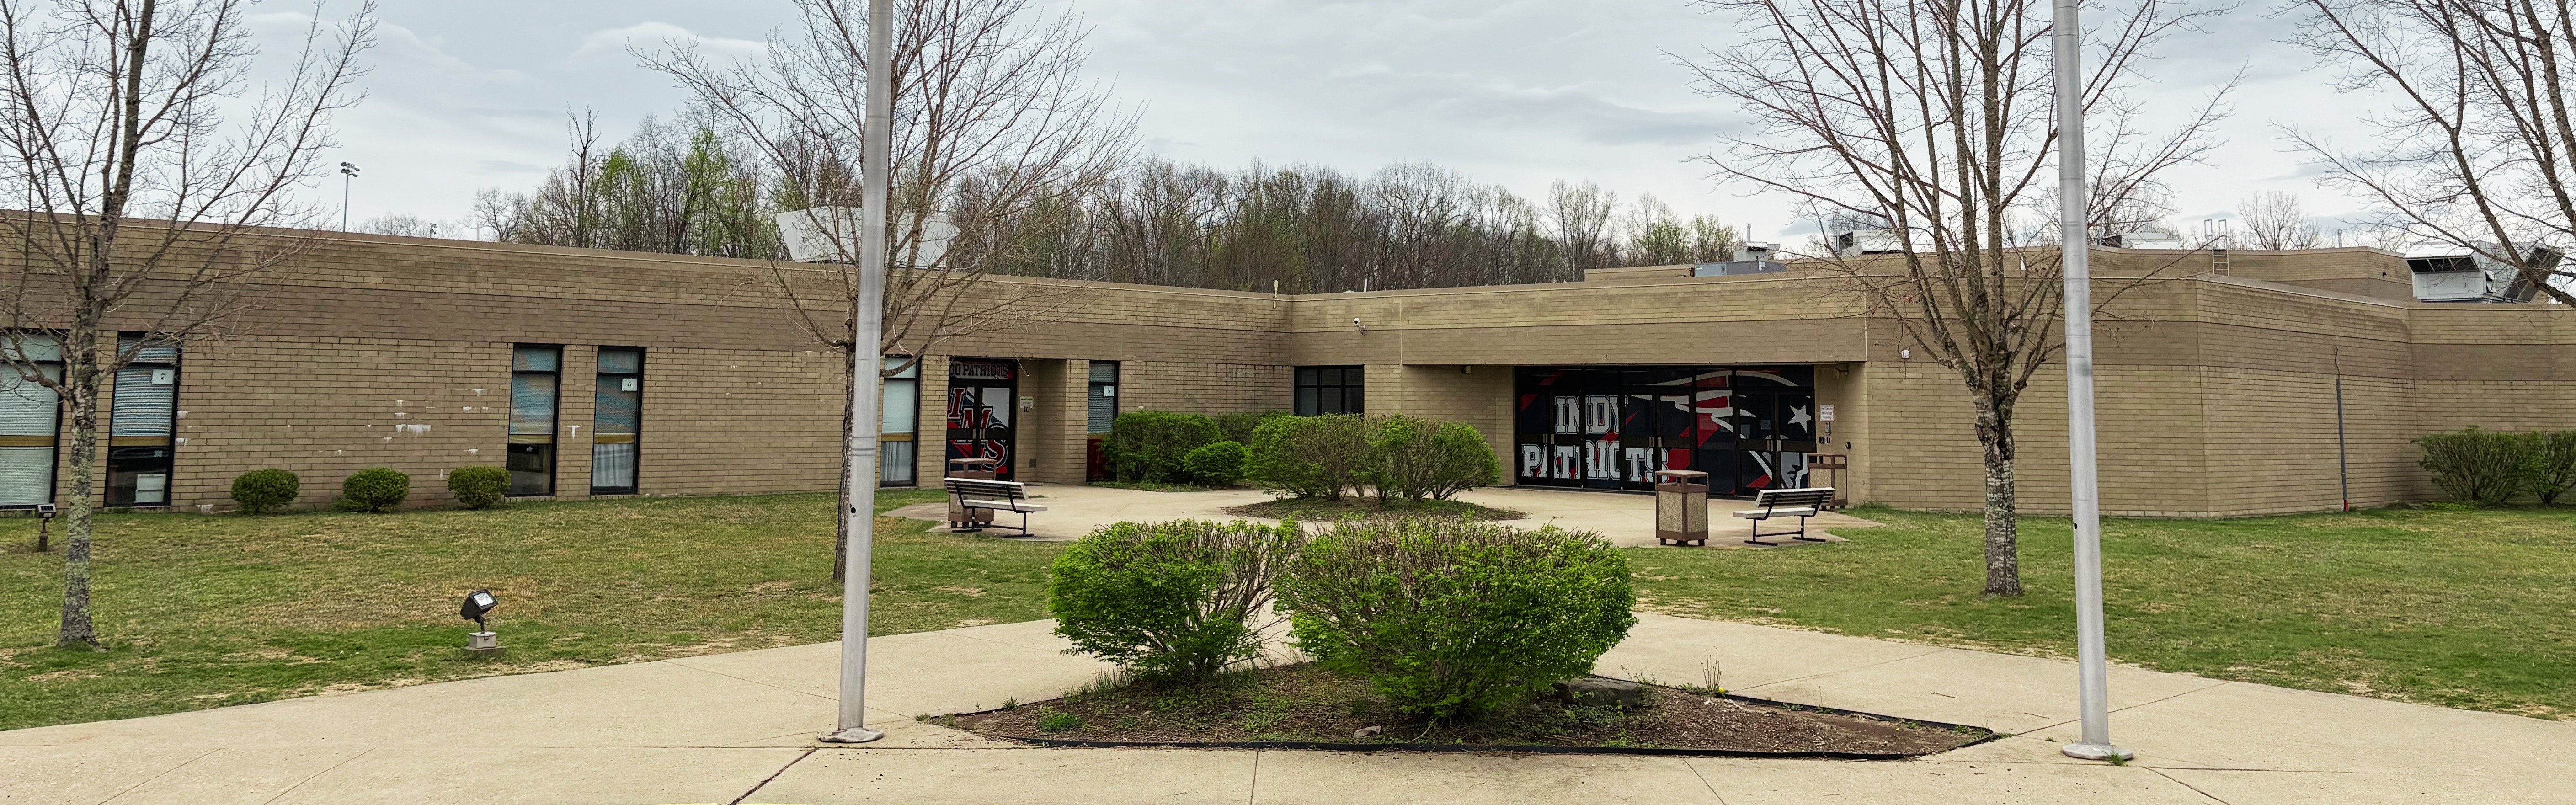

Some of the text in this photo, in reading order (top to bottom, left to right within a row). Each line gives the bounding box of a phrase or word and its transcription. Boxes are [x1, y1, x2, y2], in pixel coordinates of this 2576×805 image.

[949, 364, 1009, 377] GO PATRIOTS
[1555, 395, 1628, 434] INDY
[1522, 441, 1669, 483] PATRIOTS
